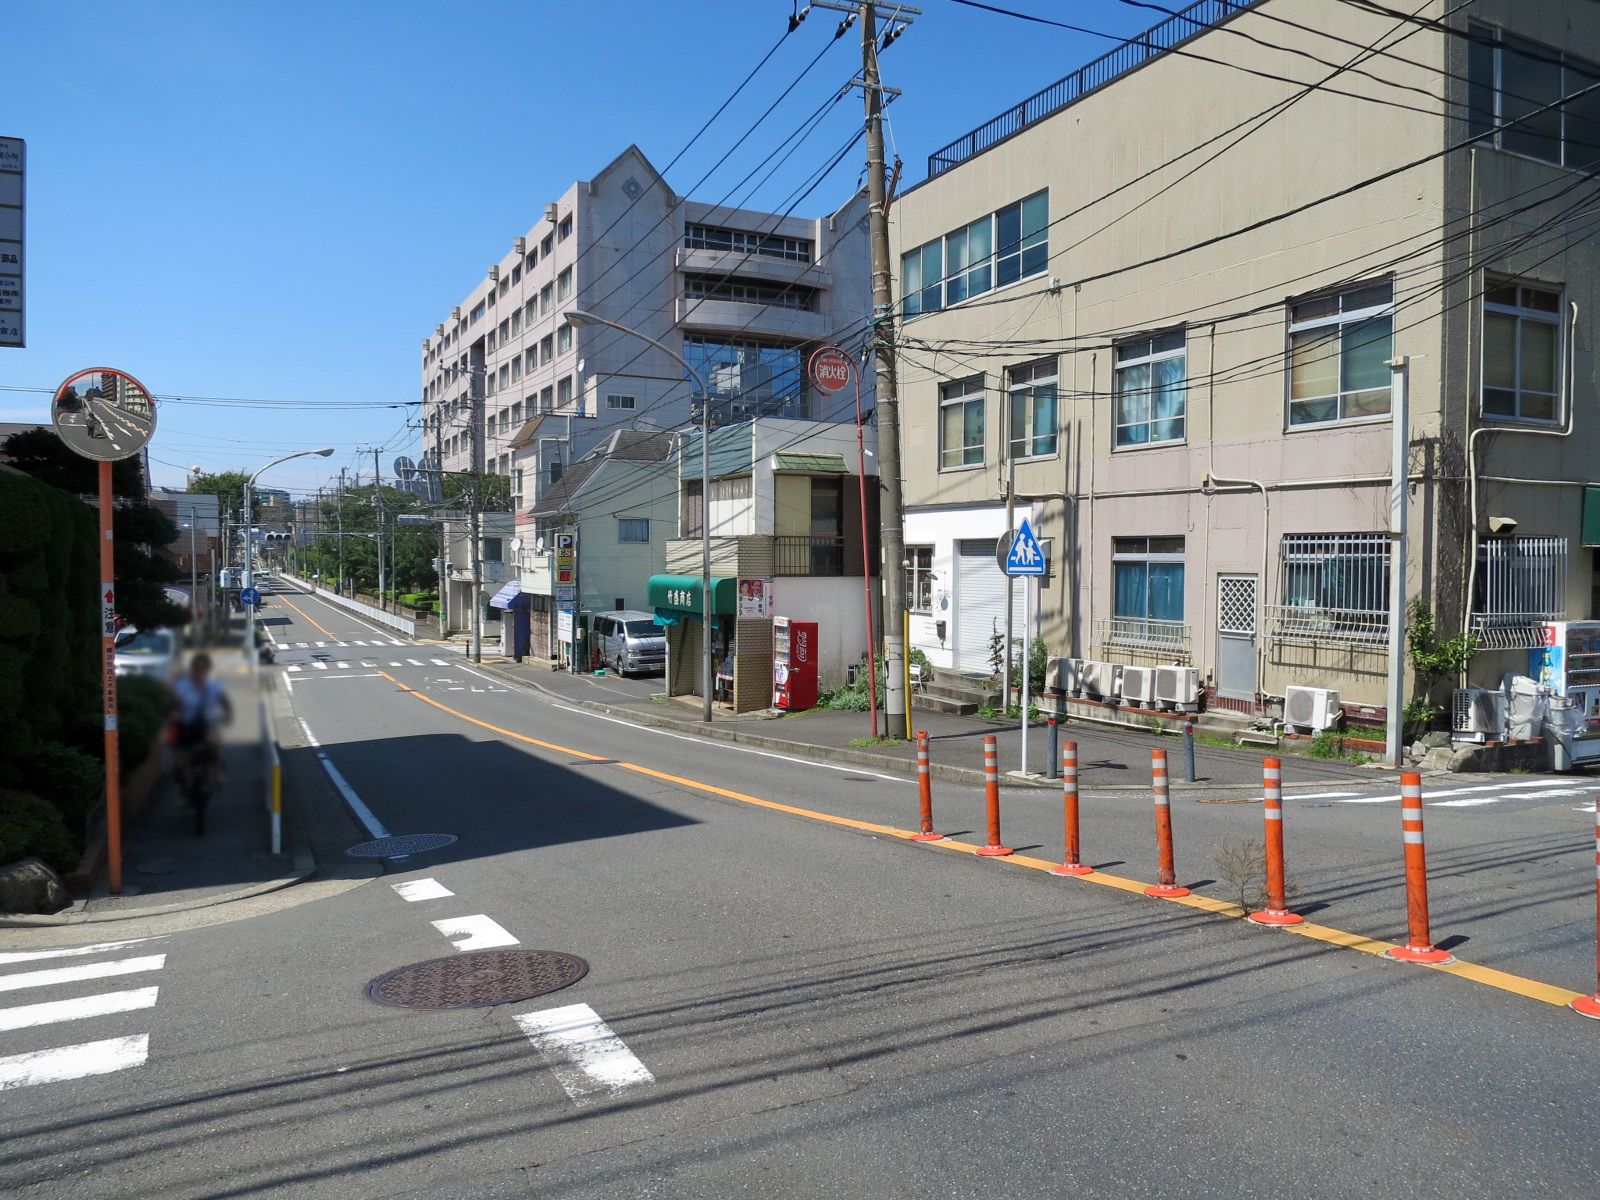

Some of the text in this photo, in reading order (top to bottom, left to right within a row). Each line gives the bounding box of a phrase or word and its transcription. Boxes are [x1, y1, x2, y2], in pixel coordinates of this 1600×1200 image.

[0, 253, 18, 264] 部品
[819, 364, 846, 380] 消火栓
[559, 535, 571, 548] P
[104, 607, 114, 634] 注意
